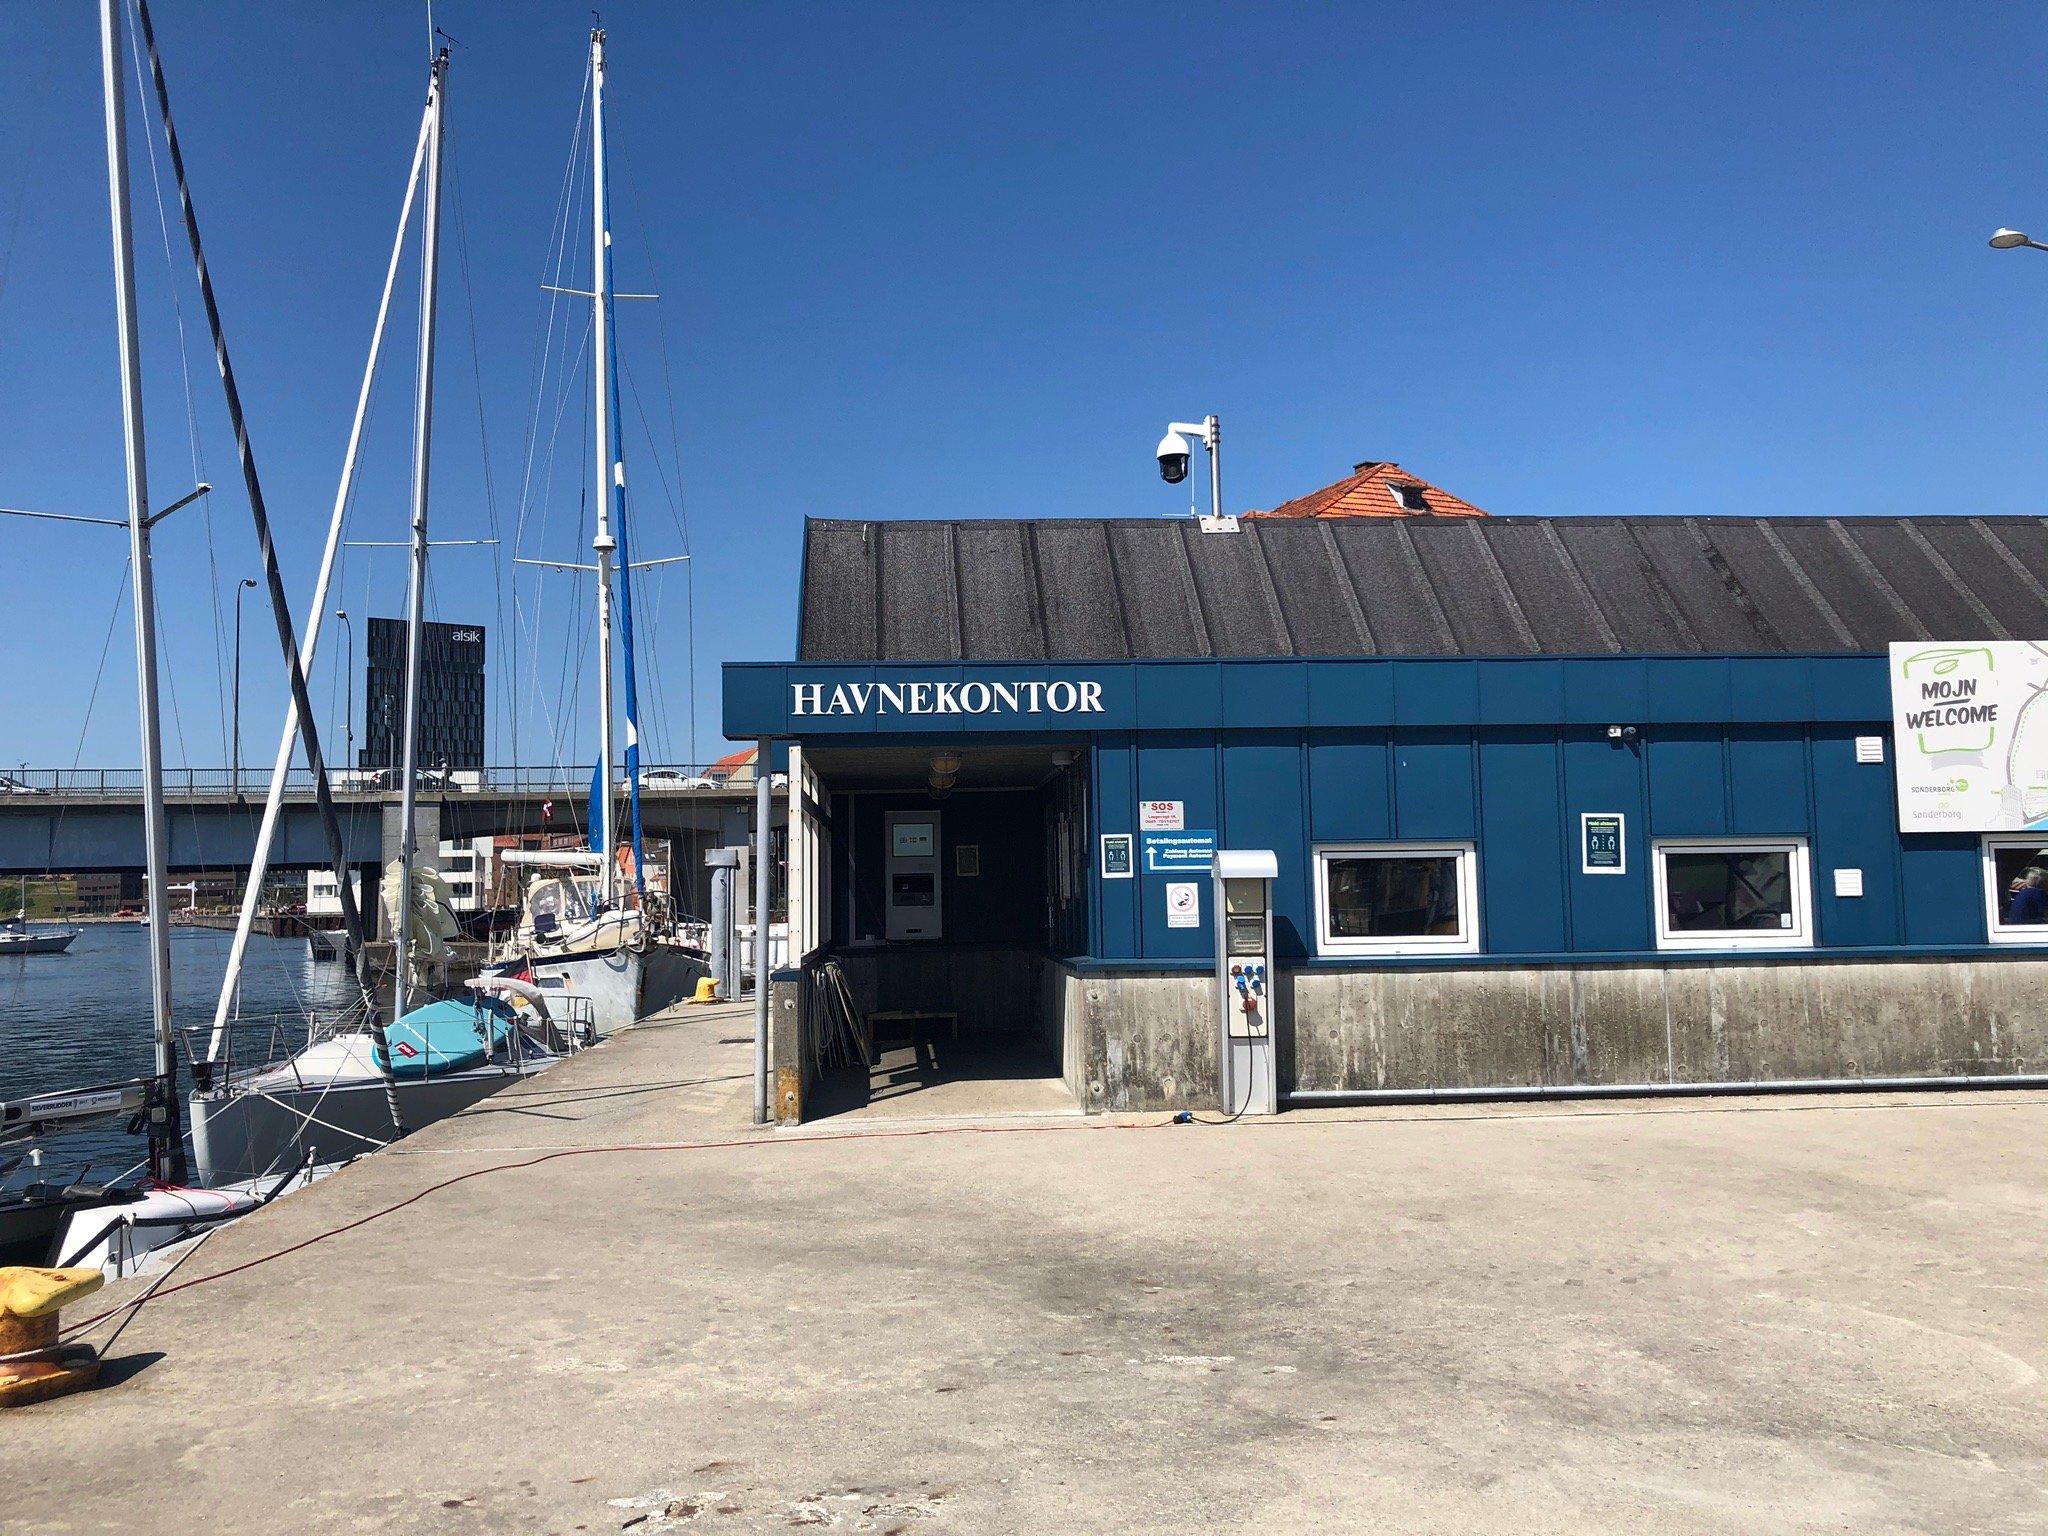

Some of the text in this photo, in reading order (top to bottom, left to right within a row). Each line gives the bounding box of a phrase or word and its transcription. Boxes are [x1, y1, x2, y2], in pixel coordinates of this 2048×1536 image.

[452, 630, 480, 643] alsik
[1921, 678, 1977, 700] MOJN
[790, 681, 1106, 715] HAVNEKONTOR
[1905, 703, 1999, 730] WELCOME
[1151, 802, 1174, 811] SOS
[1912, 810, 1962, 820] Sønderborg
[1146, 837, 1213, 845] Betalingsautomat
[31, 1101, 73, 1112] SILVERRUDDER
